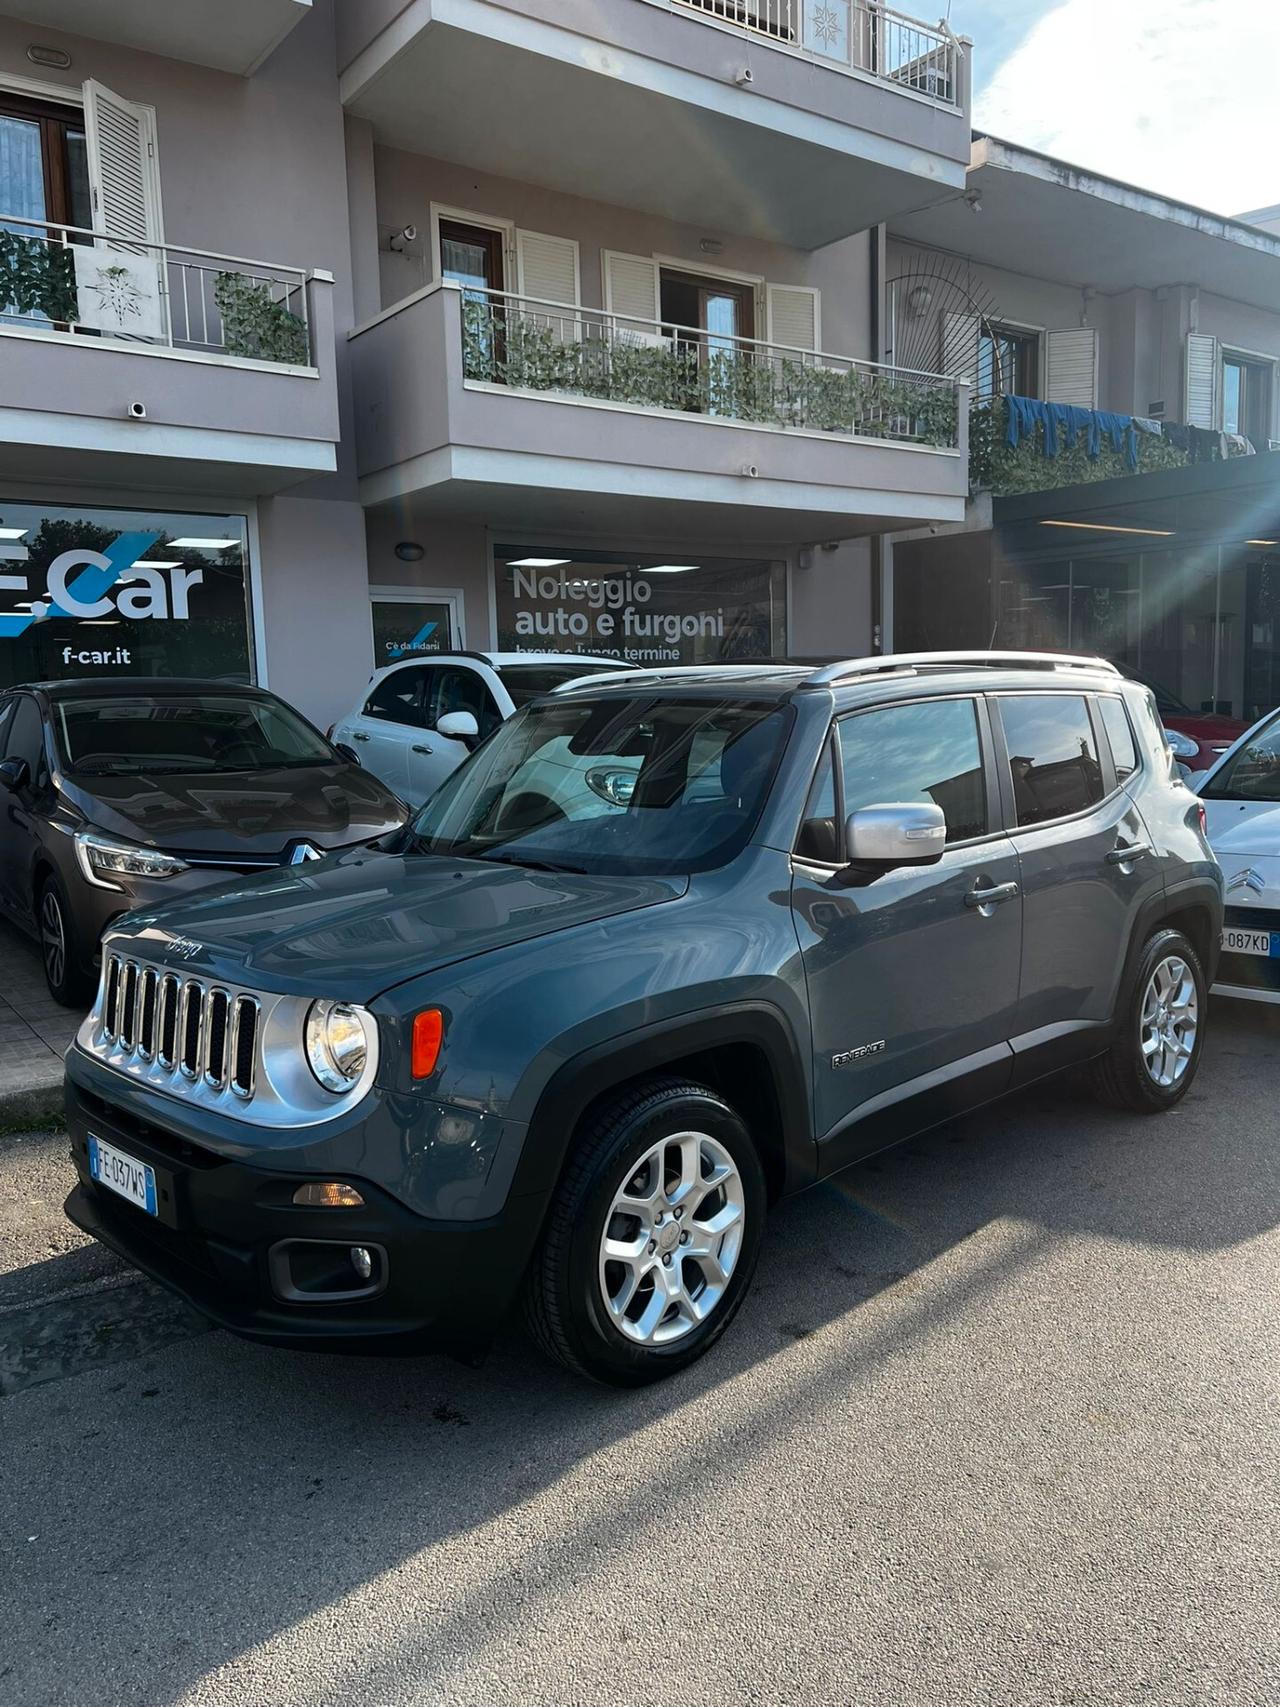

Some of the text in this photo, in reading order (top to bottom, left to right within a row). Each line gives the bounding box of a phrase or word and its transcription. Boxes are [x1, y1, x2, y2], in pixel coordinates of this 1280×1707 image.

[513, 568, 651, 608] Noleggio
[515, 607, 724, 644] auto e furgoni
[62, 647, 131, 664] f-car.it
[400, 641, 411, 650] da
[624, 645, 680, 660] termine
[831, 1040, 886, 1069] RENEGADE
